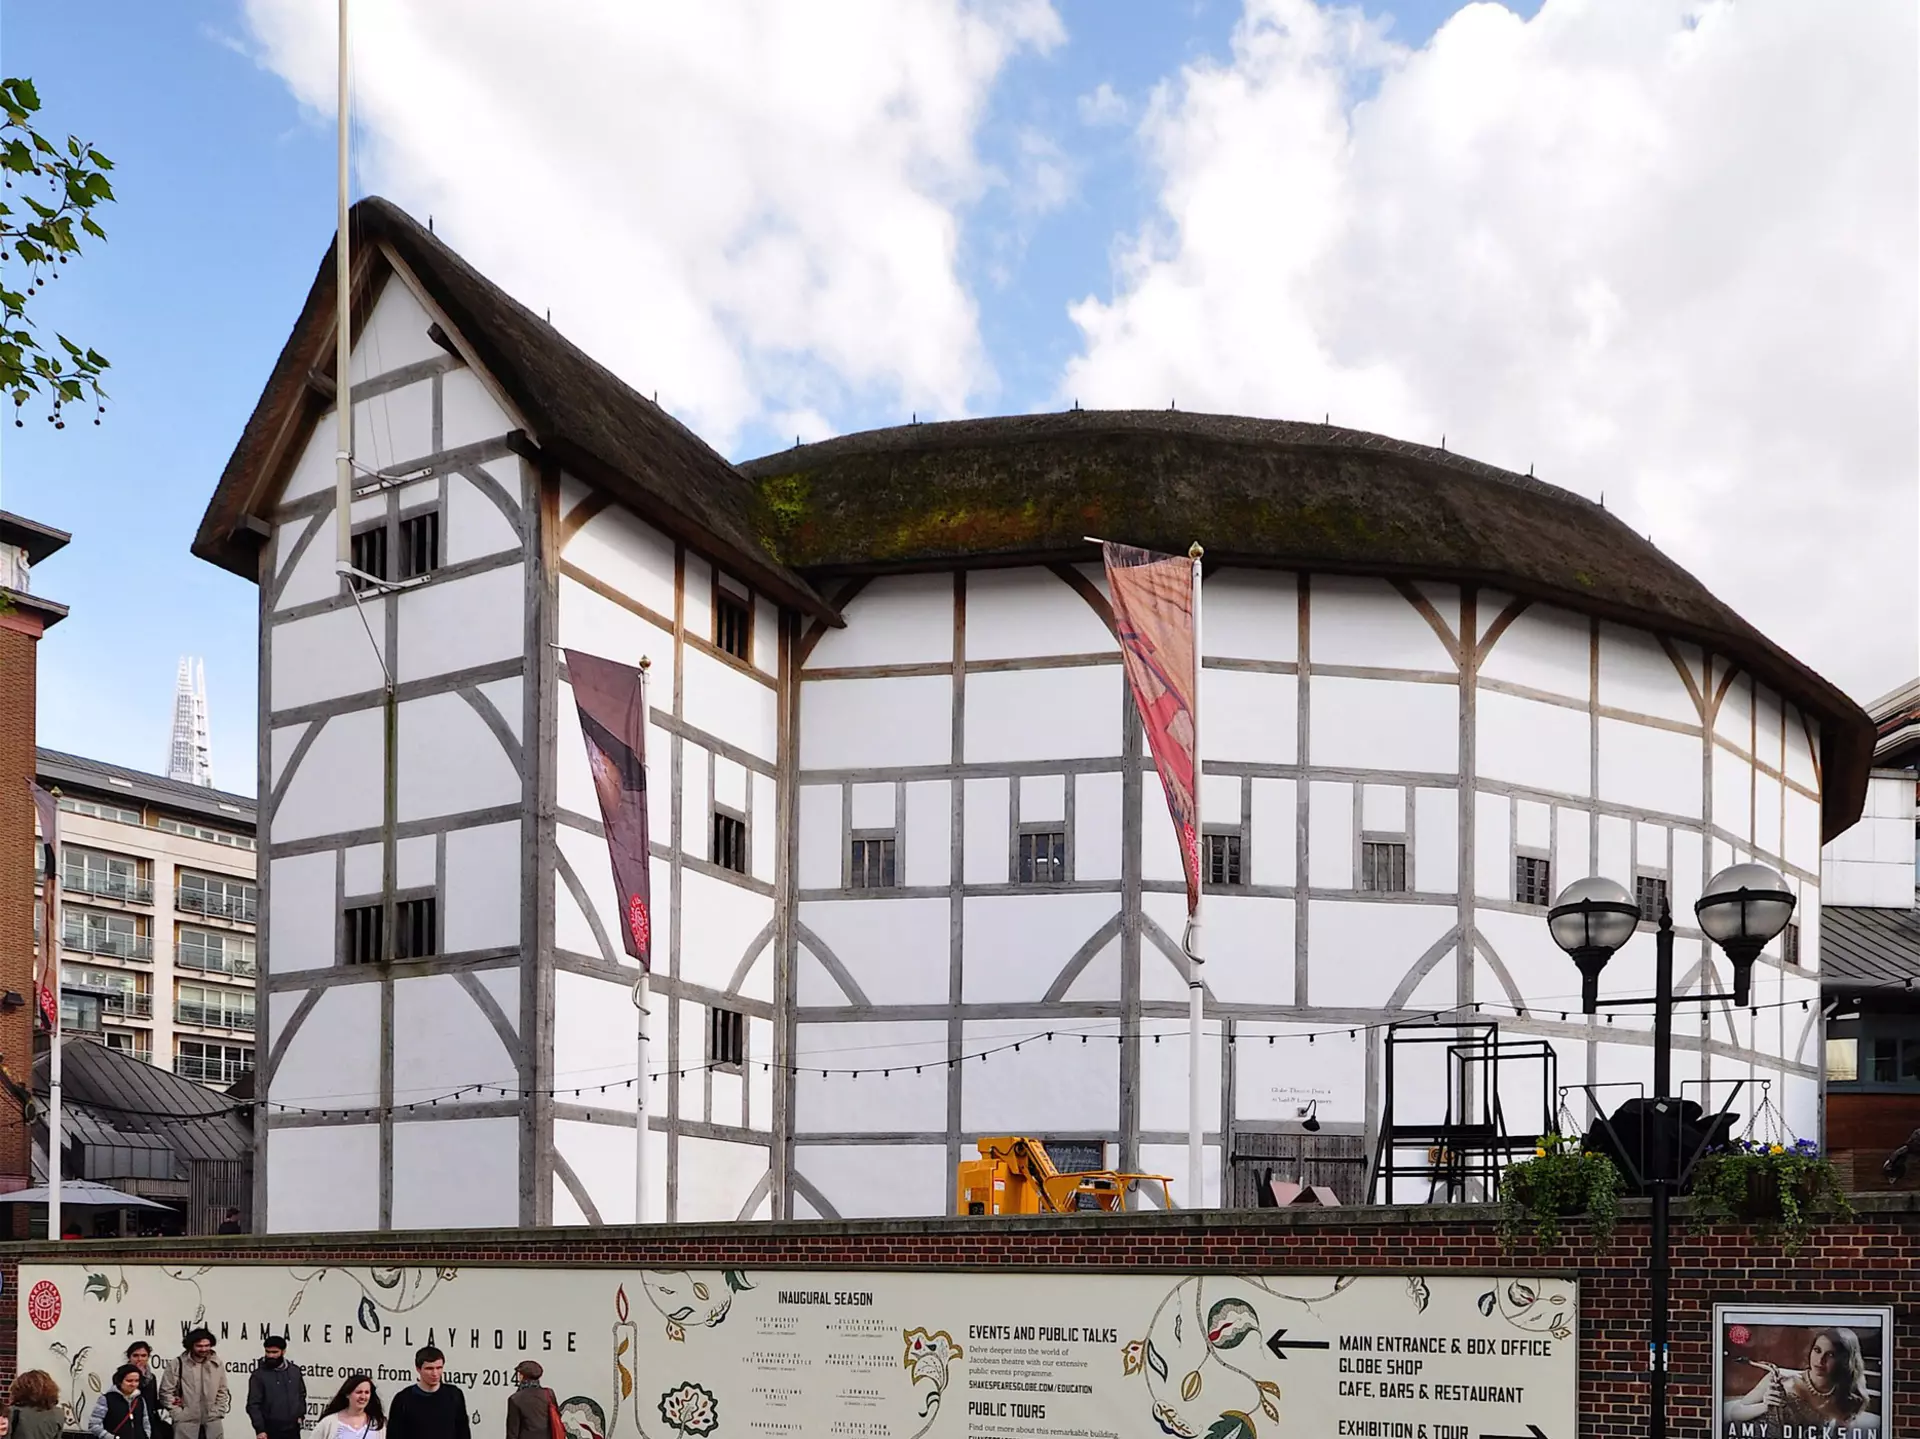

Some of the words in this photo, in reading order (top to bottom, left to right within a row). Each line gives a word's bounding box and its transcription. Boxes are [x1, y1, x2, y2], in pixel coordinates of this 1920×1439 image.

[778, 1291, 831, 1305] INAUGURAL
[834, 1292, 873, 1306] SEASON
[109, 1318, 155, 1336] SAM
[383, 1326, 576, 1352] PLAYHOUSE
[969, 1325, 1010, 1340] EVENTS
[1013, 1326, 1035, 1341] AND
[1038, 1327, 1079, 1342] PUBLIC
[1082, 1328, 1117, 1343] TALKS
[969, 1345, 988, 1354] Delve
[989, 1346, 1012, 1355] deeper
[1013, 1347, 1027, 1355] into
[1041, 1348, 1060, 1356] world
[1061, 1348, 1069, 1356] of
[1339, 1335, 1372, 1352] MAIN
[1376, 1336, 1447, 1353] ENTRANCE
[1450, 1338, 1462, 1354] &
[1467, 1338, 1496, 1355] BOX
[1501, 1340, 1552, 1356] OFFICE
[969, 1355, 1000, 1364] Jacobean
[1001, 1357, 1025, 1365] theatre
[1339, 1358, 1382, 1374] GLOBE
[1387, 1359, 1423, 1376] SHOP
[151, 1354, 172, 1370] Ou
[299, 1363, 334, 1377] eatre
[337, 1366, 373, 1379] open
[377, 1364, 412, 1381] from
[443, 1371, 478, 1389] uary
[482, 1369, 520, 1387] 2014
[969, 1367, 989, 1375] public
[1013, 1369, 1054, 1377] programme.
[969, 1380, 1093, 1394] SHAKESPEARESGLOBE.COM/EDUCATION
[1339, 1380, 1376, 1398] CAFE,
[1379, 1382, 1414, 1399] BARS
[1419, 1384, 1429, 1400] &
[1434, 1384, 1524, 1403] RESTAURANT
[968, 1401, 1007, 1416] PUBLIC
[1010, 1403, 1046, 1419] TOURS
[968, 1422, 983, 1431] Find
[1050, 1428, 1089, 1437] remarkable
[1338, 1420, 1413, 1439] EXHIBITION
[1417, 1424, 1428, 1439] &
[1433, 1424, 1469, 1439] TOUR
[1728, 1422, 1768, 1437] AMY
[1783, 1424, 1877, 1439] DICKSON
